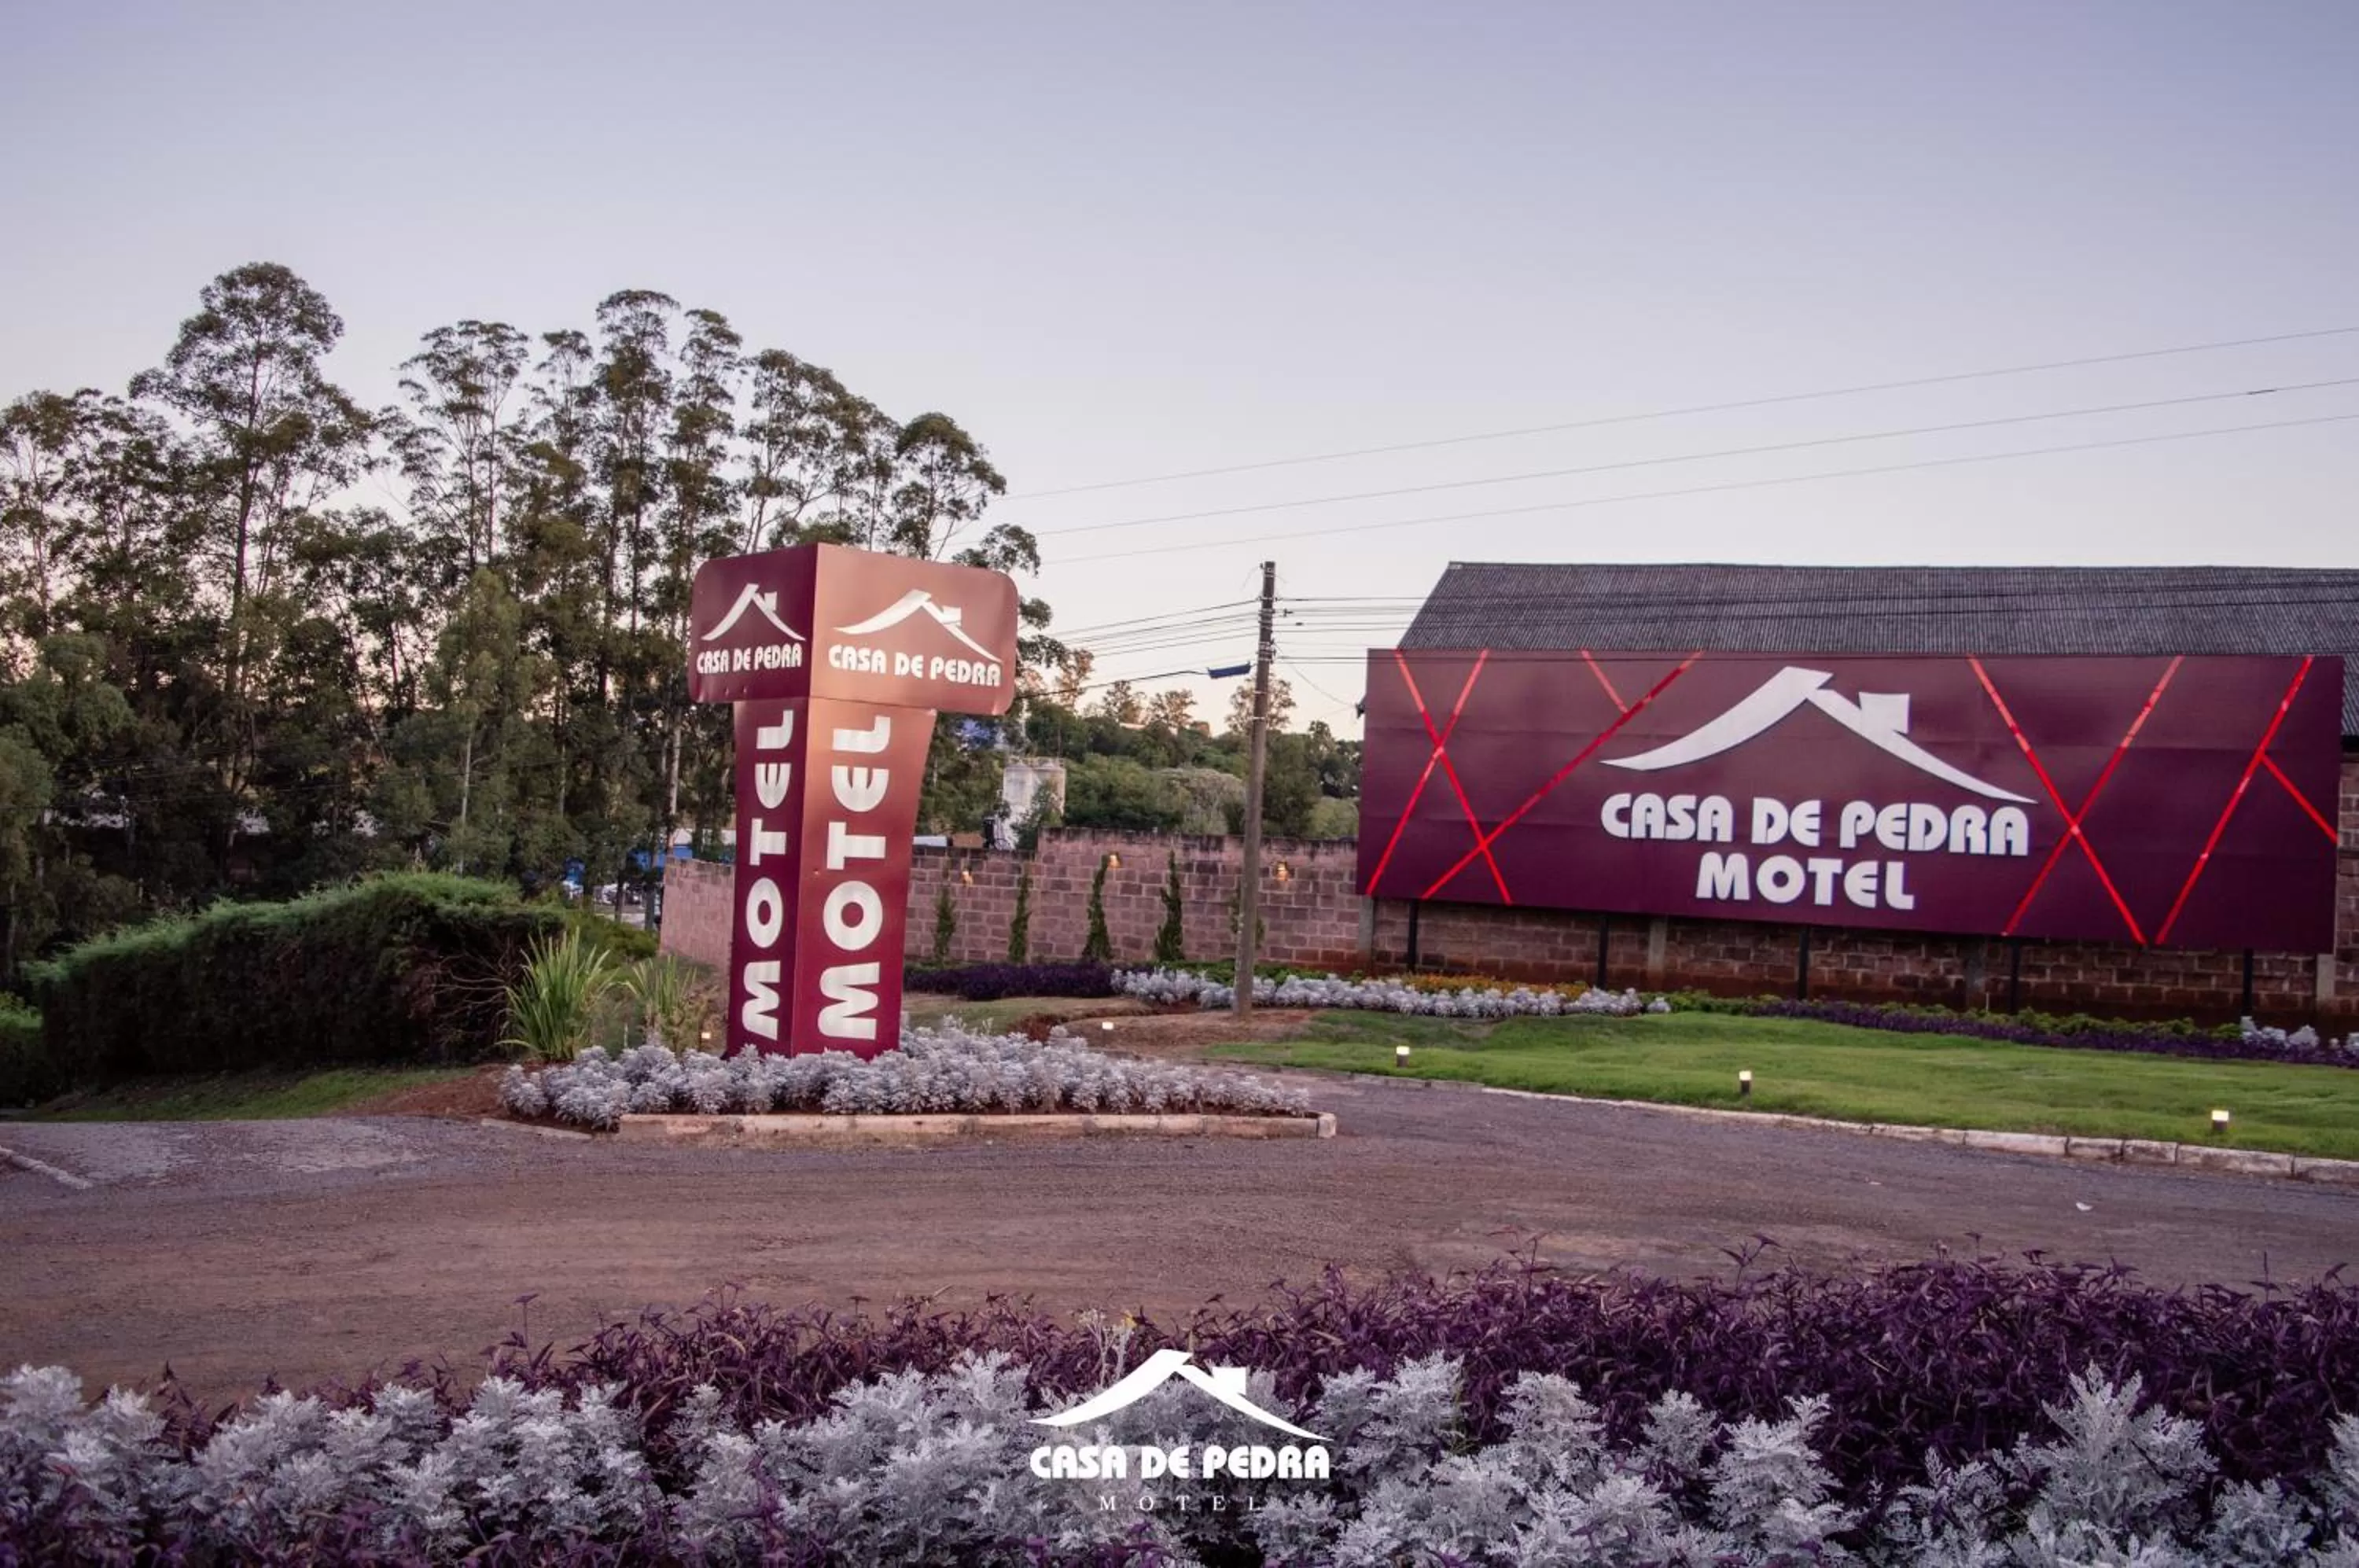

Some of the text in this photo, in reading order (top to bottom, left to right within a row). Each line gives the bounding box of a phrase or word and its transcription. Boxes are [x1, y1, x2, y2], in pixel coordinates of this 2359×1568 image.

[697, 642, 803, 675] CASA DE PEDRA
[828, 644, 1001, 687] CASA DE PEDRA
[1600, 792, 2029, 856] CASA DE PEDRA
[742, 709, 793, 1041] MOTEL
[818, 716, 891, 1040] MOTEL
[1695, 852, 1916, 910] MOTEL
